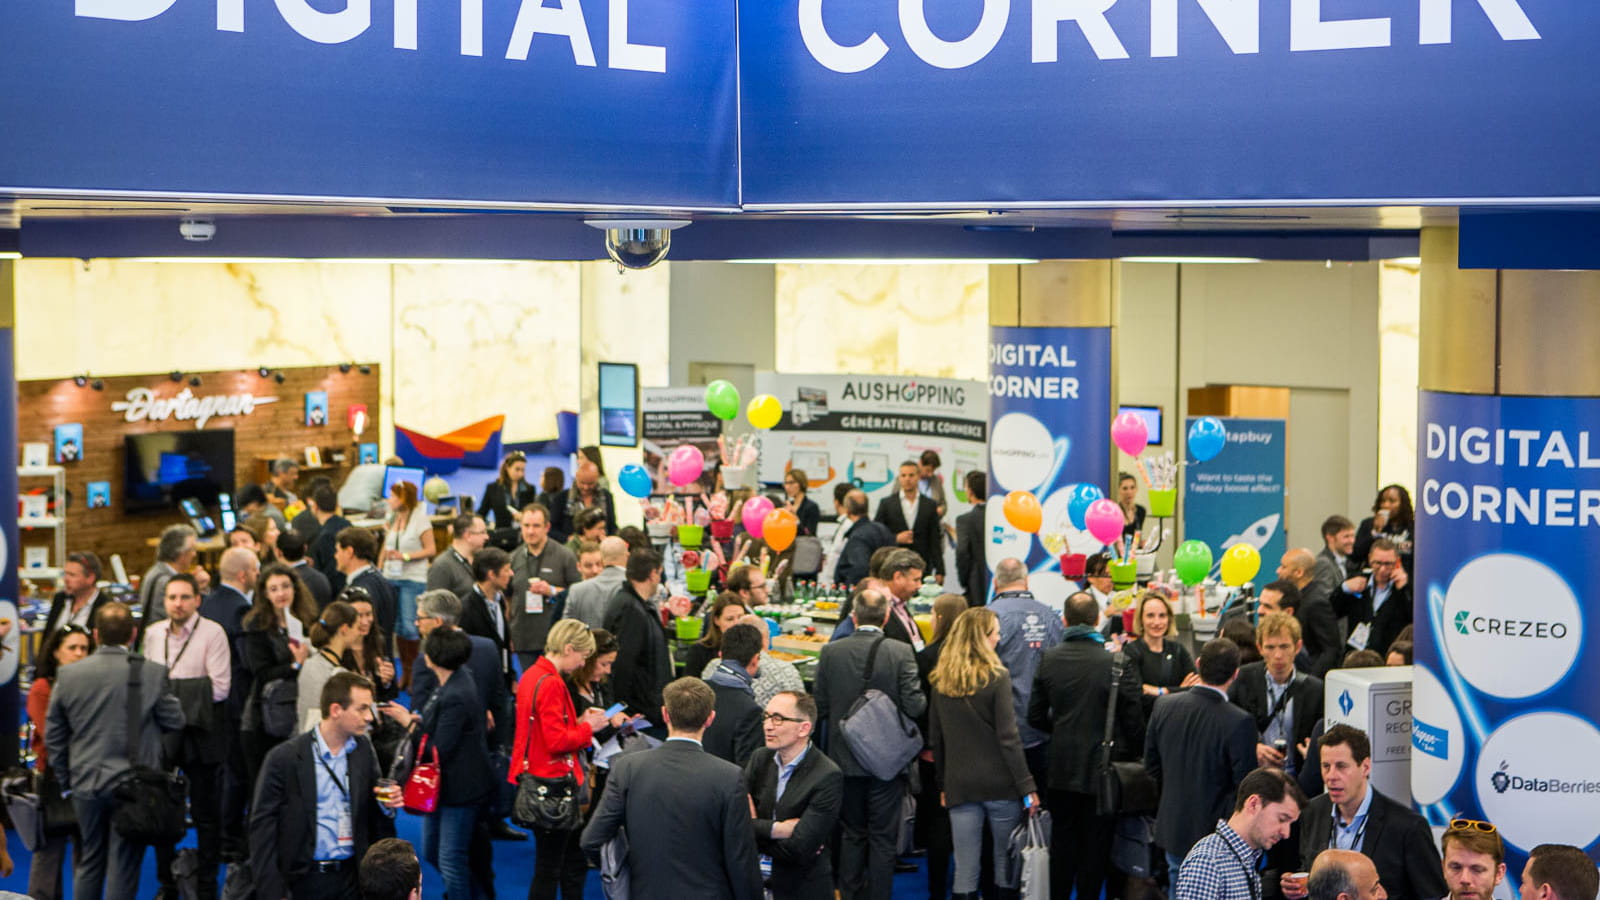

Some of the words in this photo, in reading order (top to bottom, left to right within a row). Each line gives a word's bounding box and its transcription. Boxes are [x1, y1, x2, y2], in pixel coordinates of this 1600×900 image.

[988, 344, 1077, 367] DIGITAL
[842, 381, 965, 406] AUSHOPPING
[987, 374, 1079, 399] CORNER
[113, 387, 275, 430] Dartagnan
[841, 415, 919, 431] GÉNÉRATEUR
[921, 420, 936, 433] DE
[937, 421, 983, 438] COMMERCE
[1226, 431, 1272, 444] tapbuy
[1426, 423, 1600, 468] DIGITAL
[1190, 483, 1223, 494] Tapbuy
[1196, 473, 1221, 482] Want
[1222, 474, 1233, 482] to
[1423, 478, 1600, 526] CORNER
[1472, 617, 1567, 639] CREZEO
[1512, 776, 1600, 793] DataBerries
